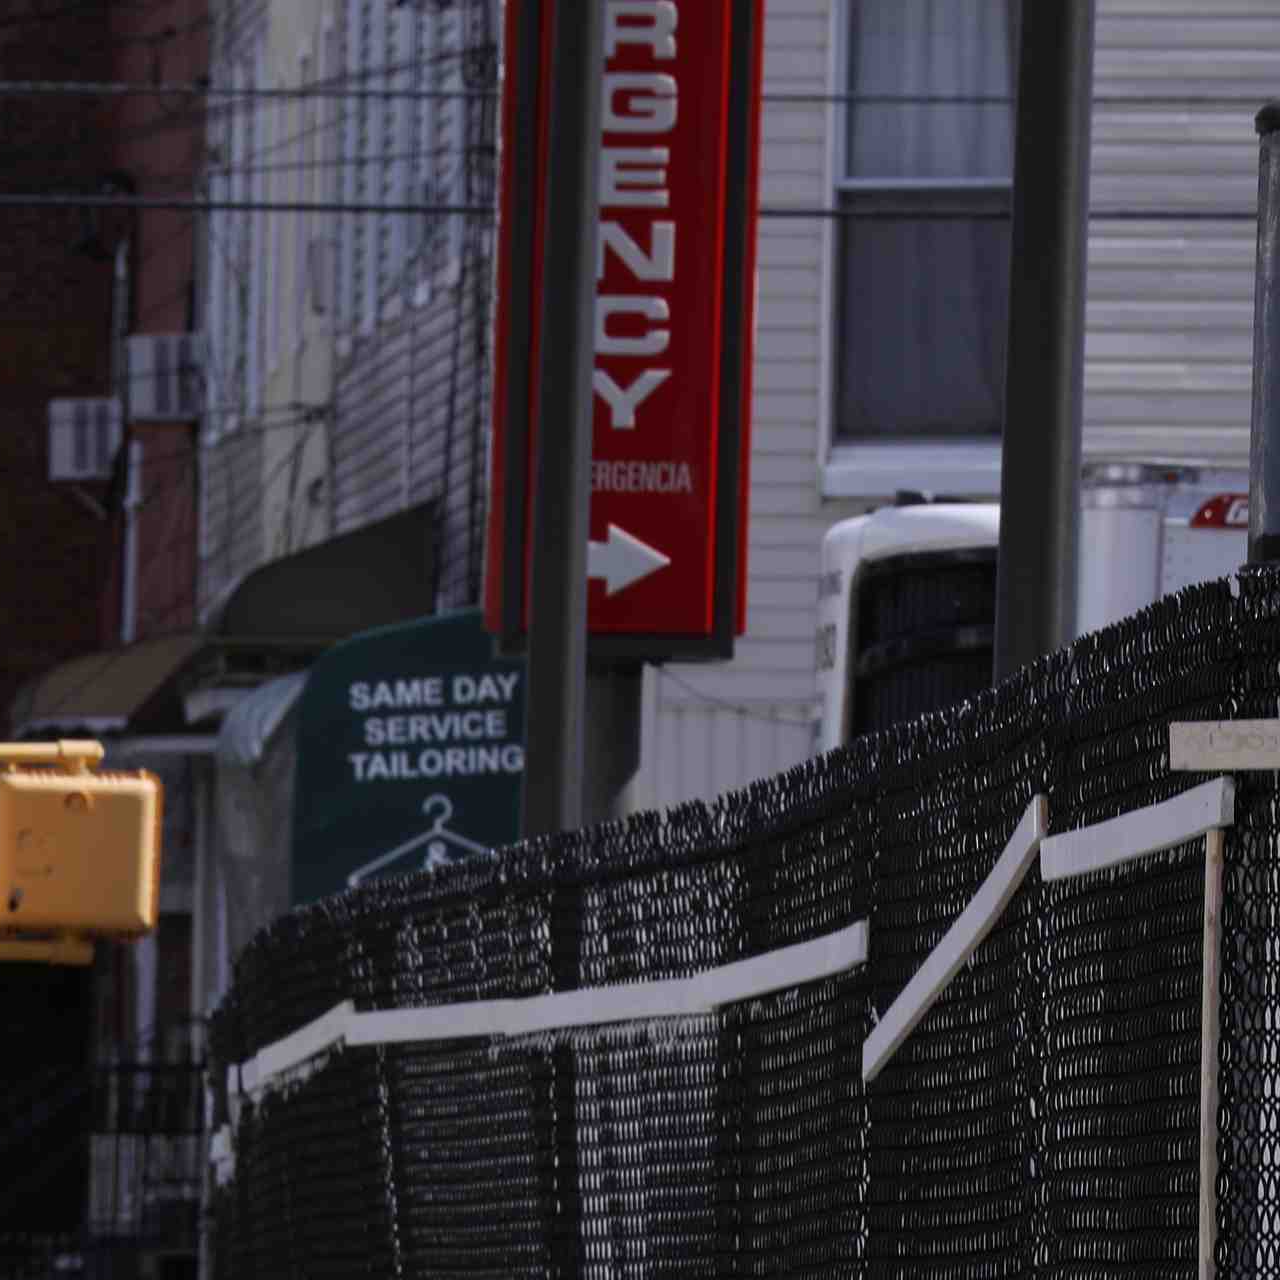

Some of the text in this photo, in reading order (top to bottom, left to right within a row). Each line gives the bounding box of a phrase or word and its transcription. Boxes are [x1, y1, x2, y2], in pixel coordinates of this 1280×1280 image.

[349, 673, 518, 710] SAME DAY
[364, 710, 507, 745] SERVICE
[349, 745, 525, 781] TAILORING
